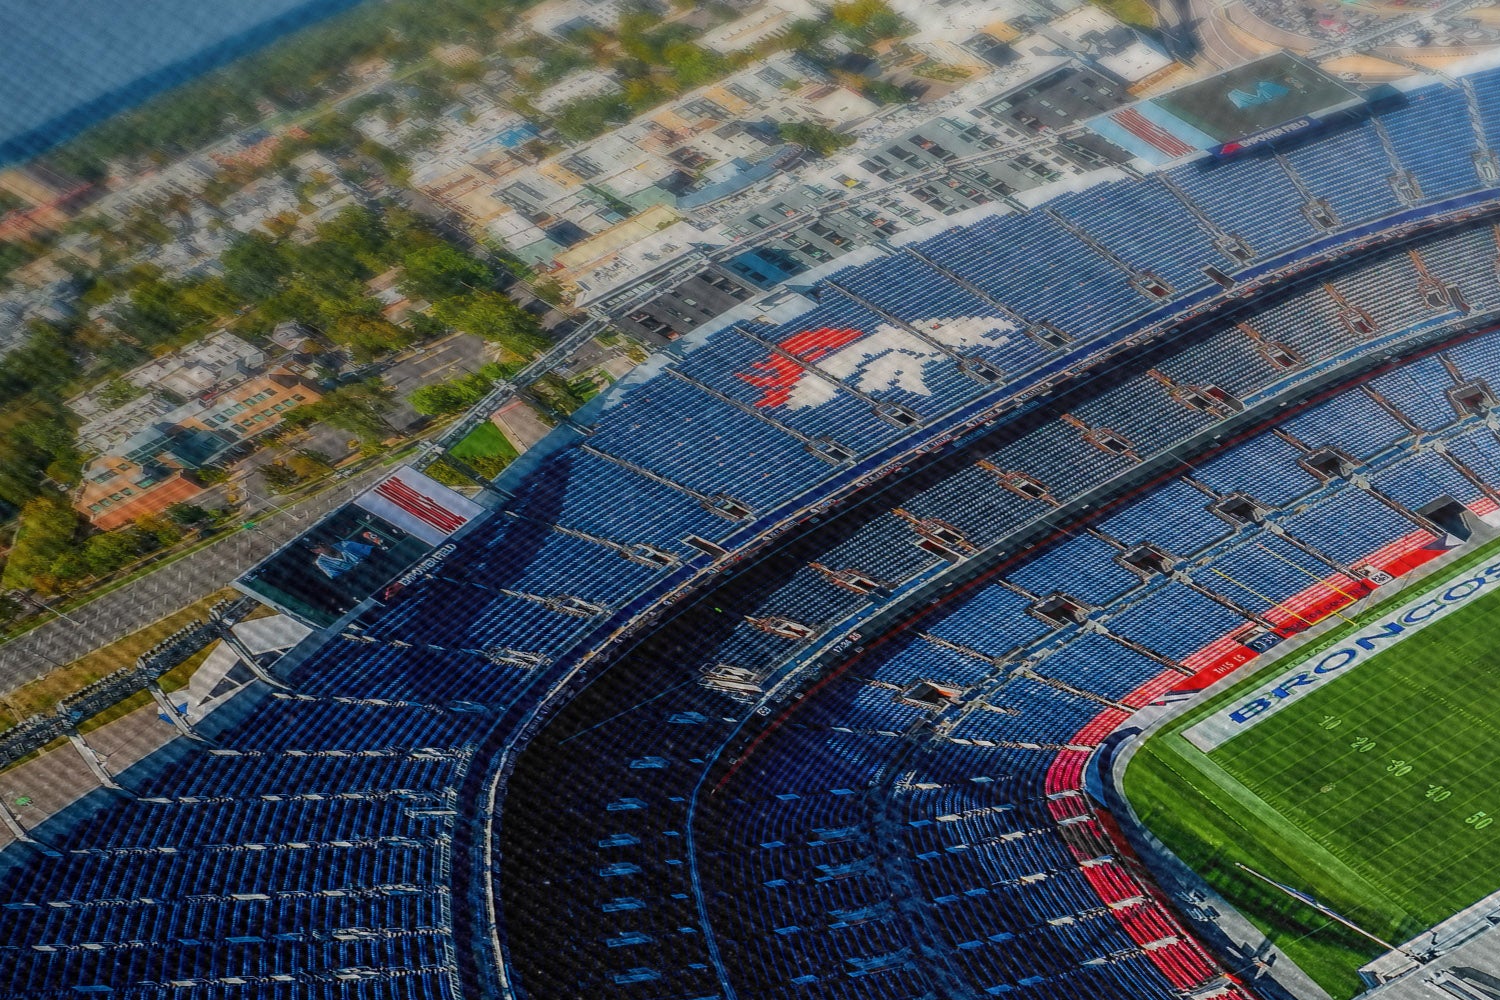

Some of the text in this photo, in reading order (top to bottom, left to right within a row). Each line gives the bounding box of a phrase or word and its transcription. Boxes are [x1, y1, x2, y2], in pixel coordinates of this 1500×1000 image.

[1318, 715, 1342, 730] 10
[1350, 736, 1377, 753] 20
[1386, 759, 1413, 777] 30
[1425, 783, 1452, 802] 40
[1465, 811, 1494, 830] 50
